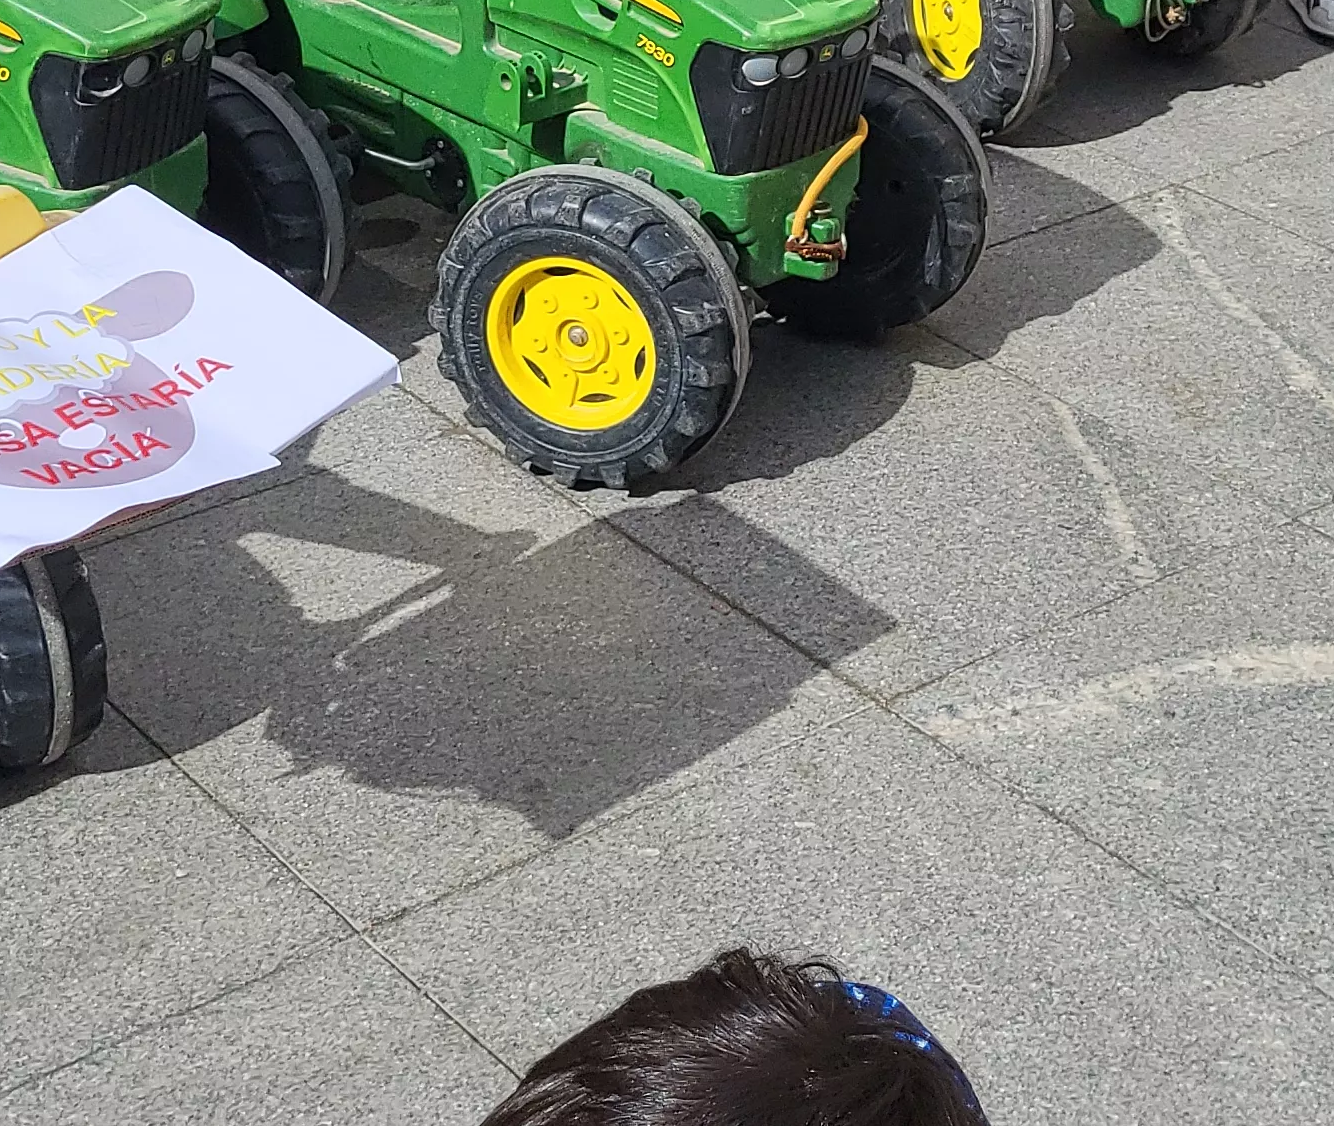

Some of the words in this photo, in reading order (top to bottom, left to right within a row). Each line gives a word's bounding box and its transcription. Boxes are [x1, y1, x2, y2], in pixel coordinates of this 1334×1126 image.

[636, 33, 675, 67] 7930
[16, 328, 50, 350] Y
[53, 304, 119, 338] LA
[53, 355, 234, 431] ESTARÍA
[20, 429, 171, 486] VACÍA
